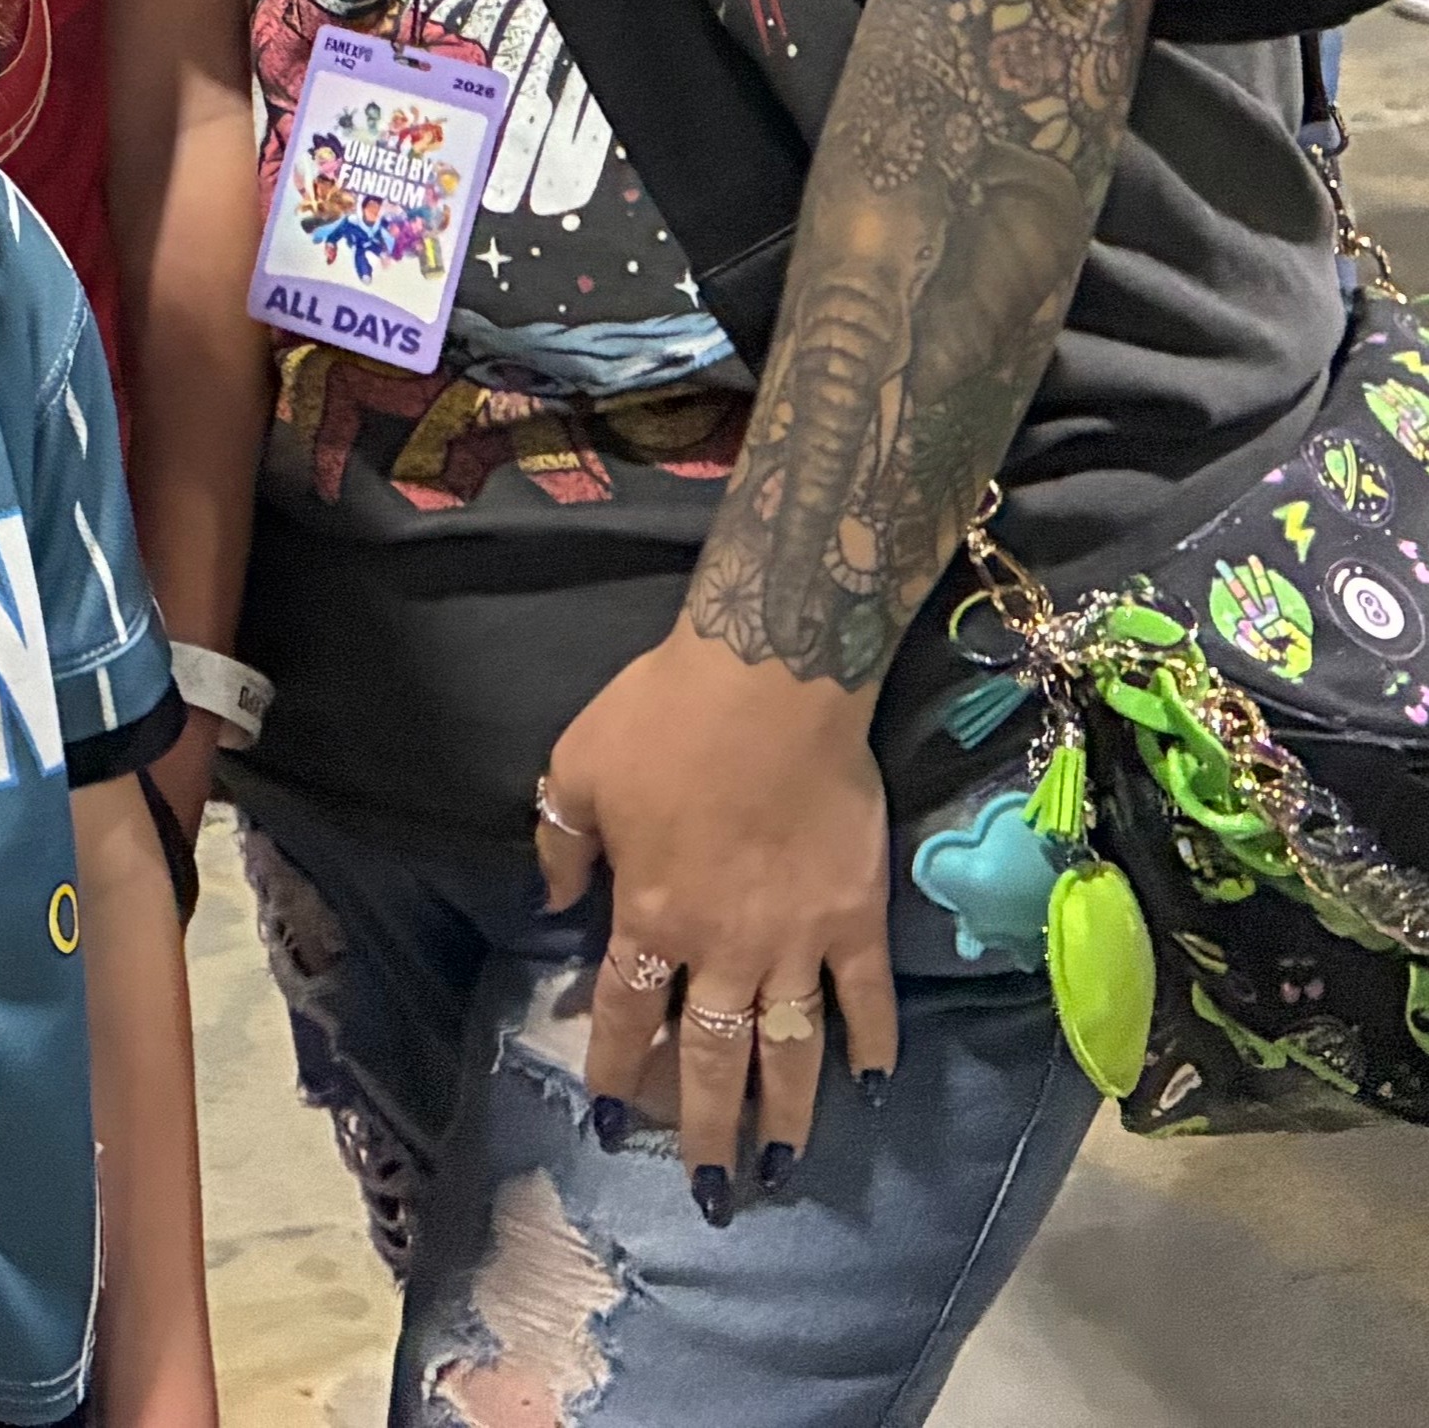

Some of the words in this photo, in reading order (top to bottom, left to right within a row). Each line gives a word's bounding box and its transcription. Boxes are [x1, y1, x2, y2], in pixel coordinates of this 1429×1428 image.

[343, 139, 409, 177] UNITED
[407, 156, 433, 184] BY
[338, 162, 427, 210] FANDOM
[265, 284, 323, 326] ALL
[332, 304, 423, 355] DAYS
